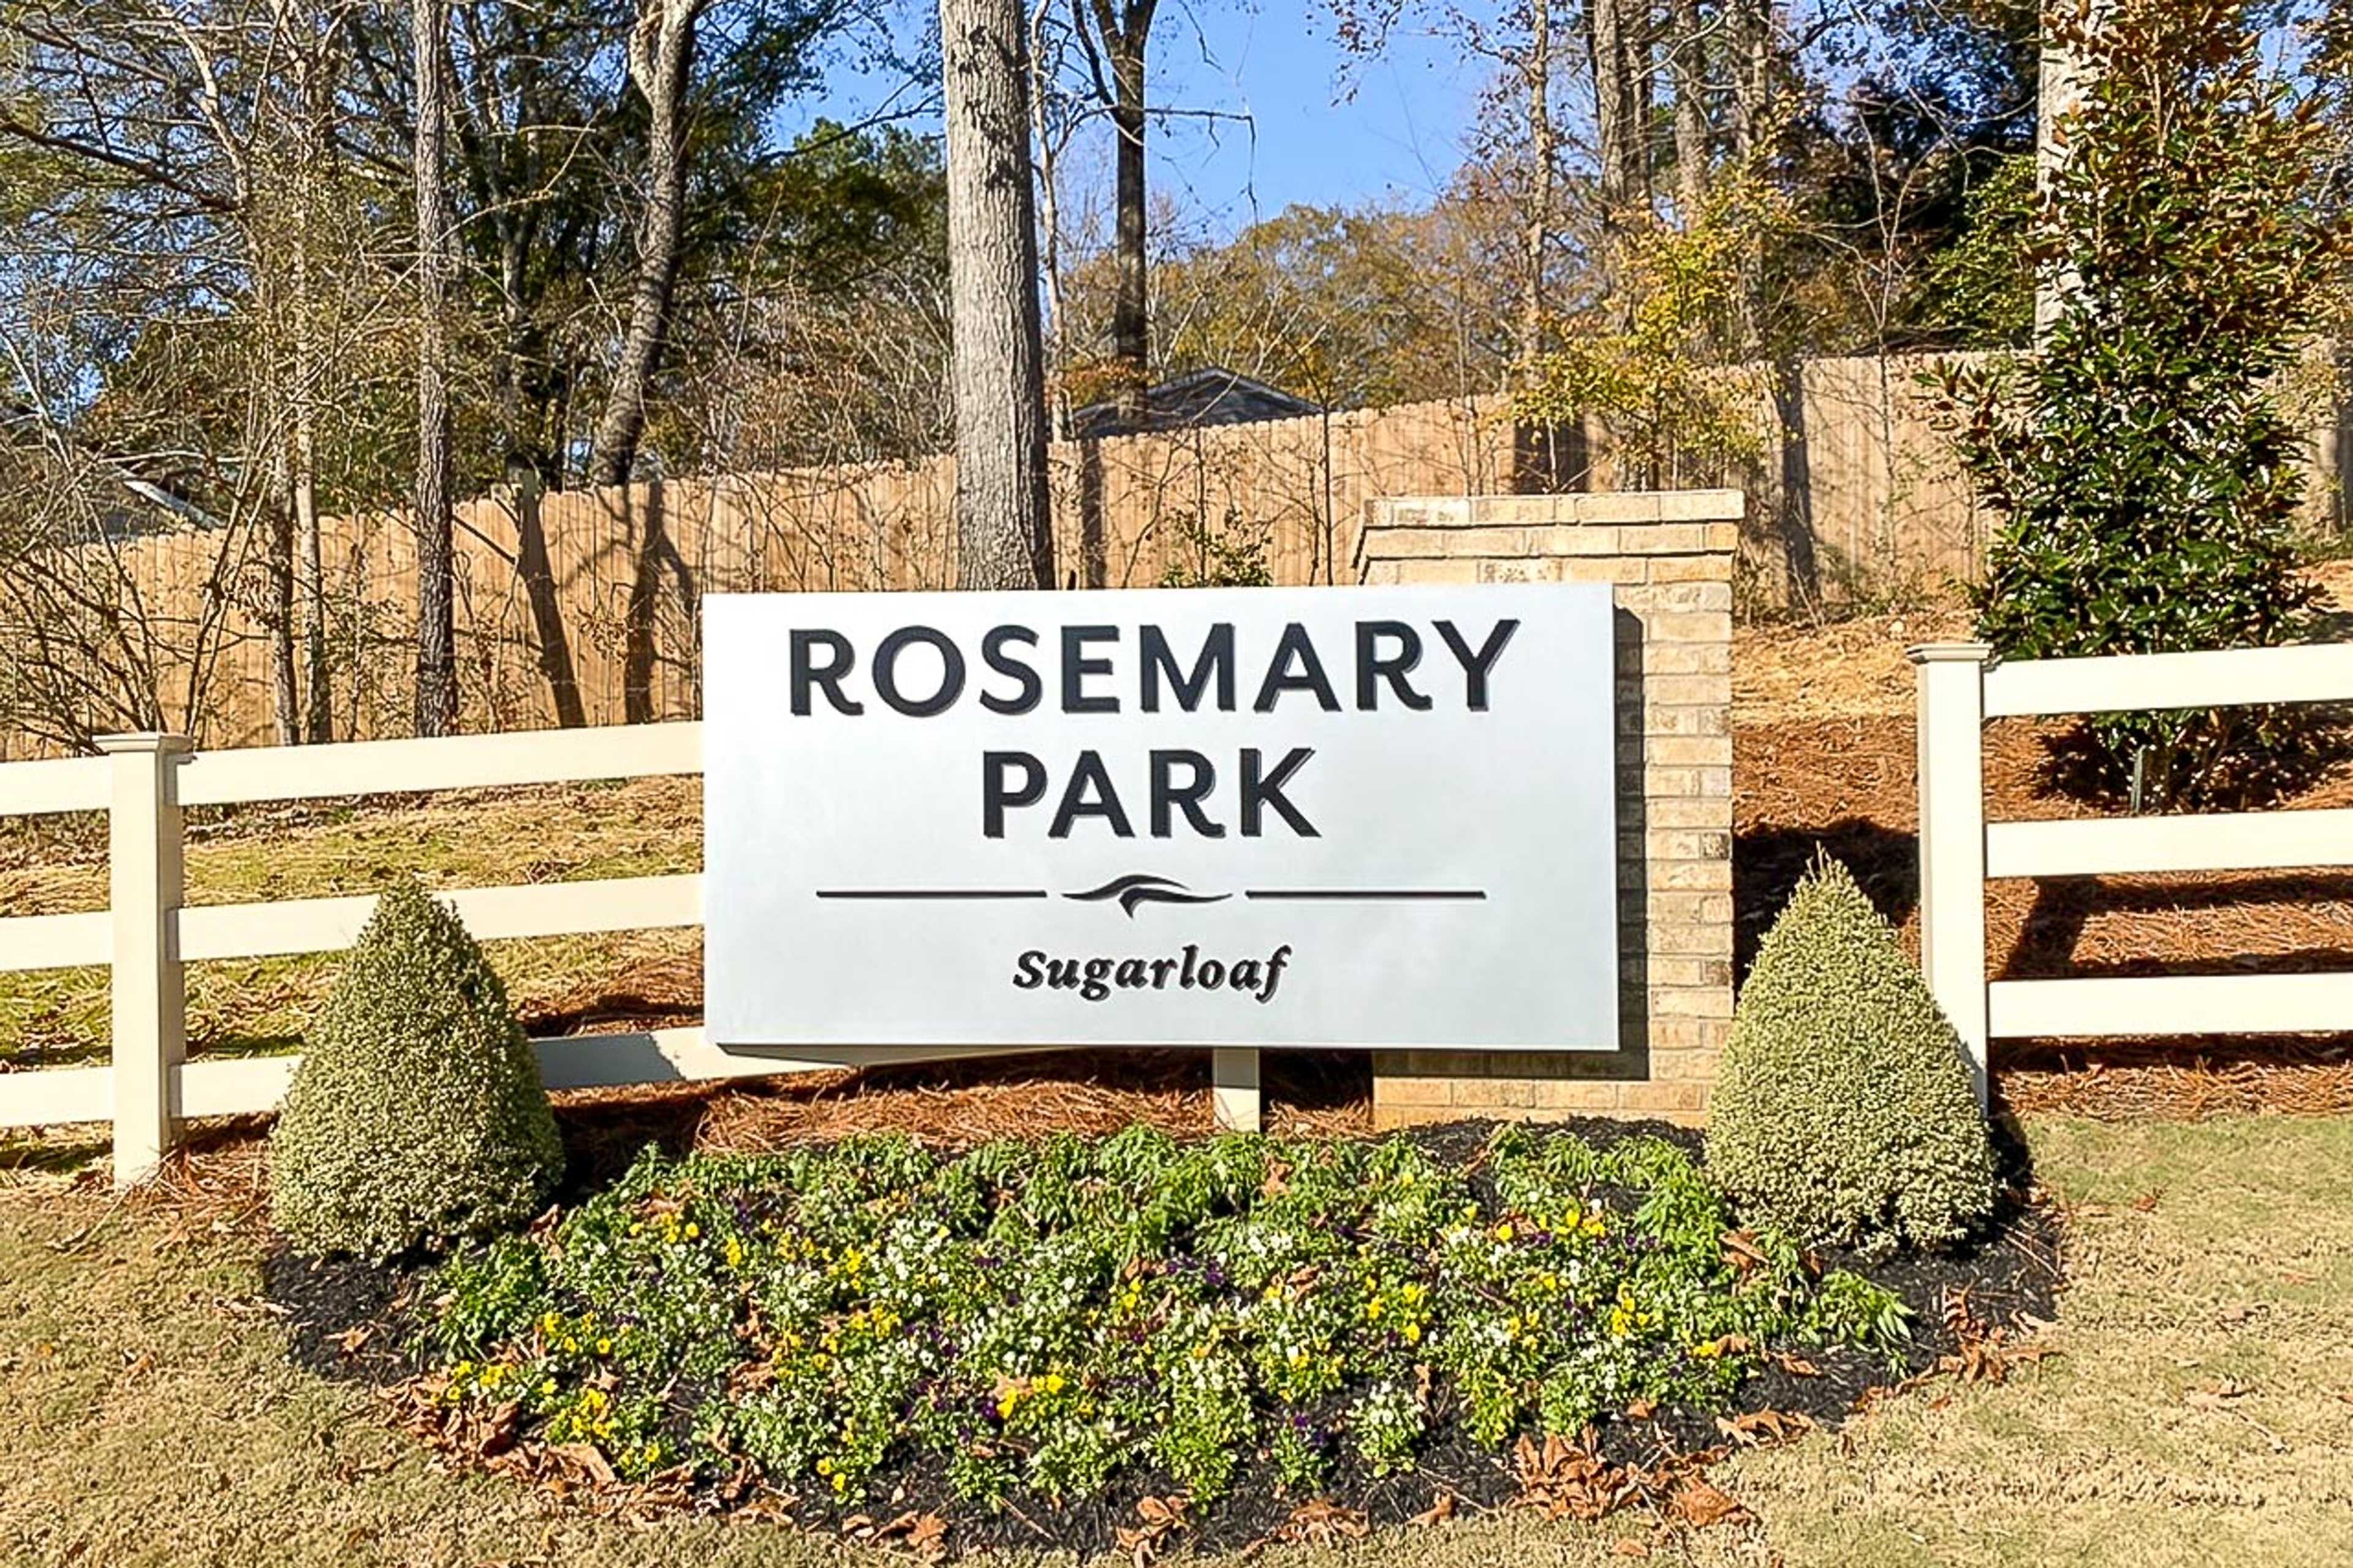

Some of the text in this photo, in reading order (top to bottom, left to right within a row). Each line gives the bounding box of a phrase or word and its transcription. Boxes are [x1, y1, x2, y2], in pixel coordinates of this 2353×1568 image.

[789, 618, 1520, 718] ROSEMARY
[982, 747, 1321, 839] PARK
[1012, 944, 1292, 1004] Sugarloaf
